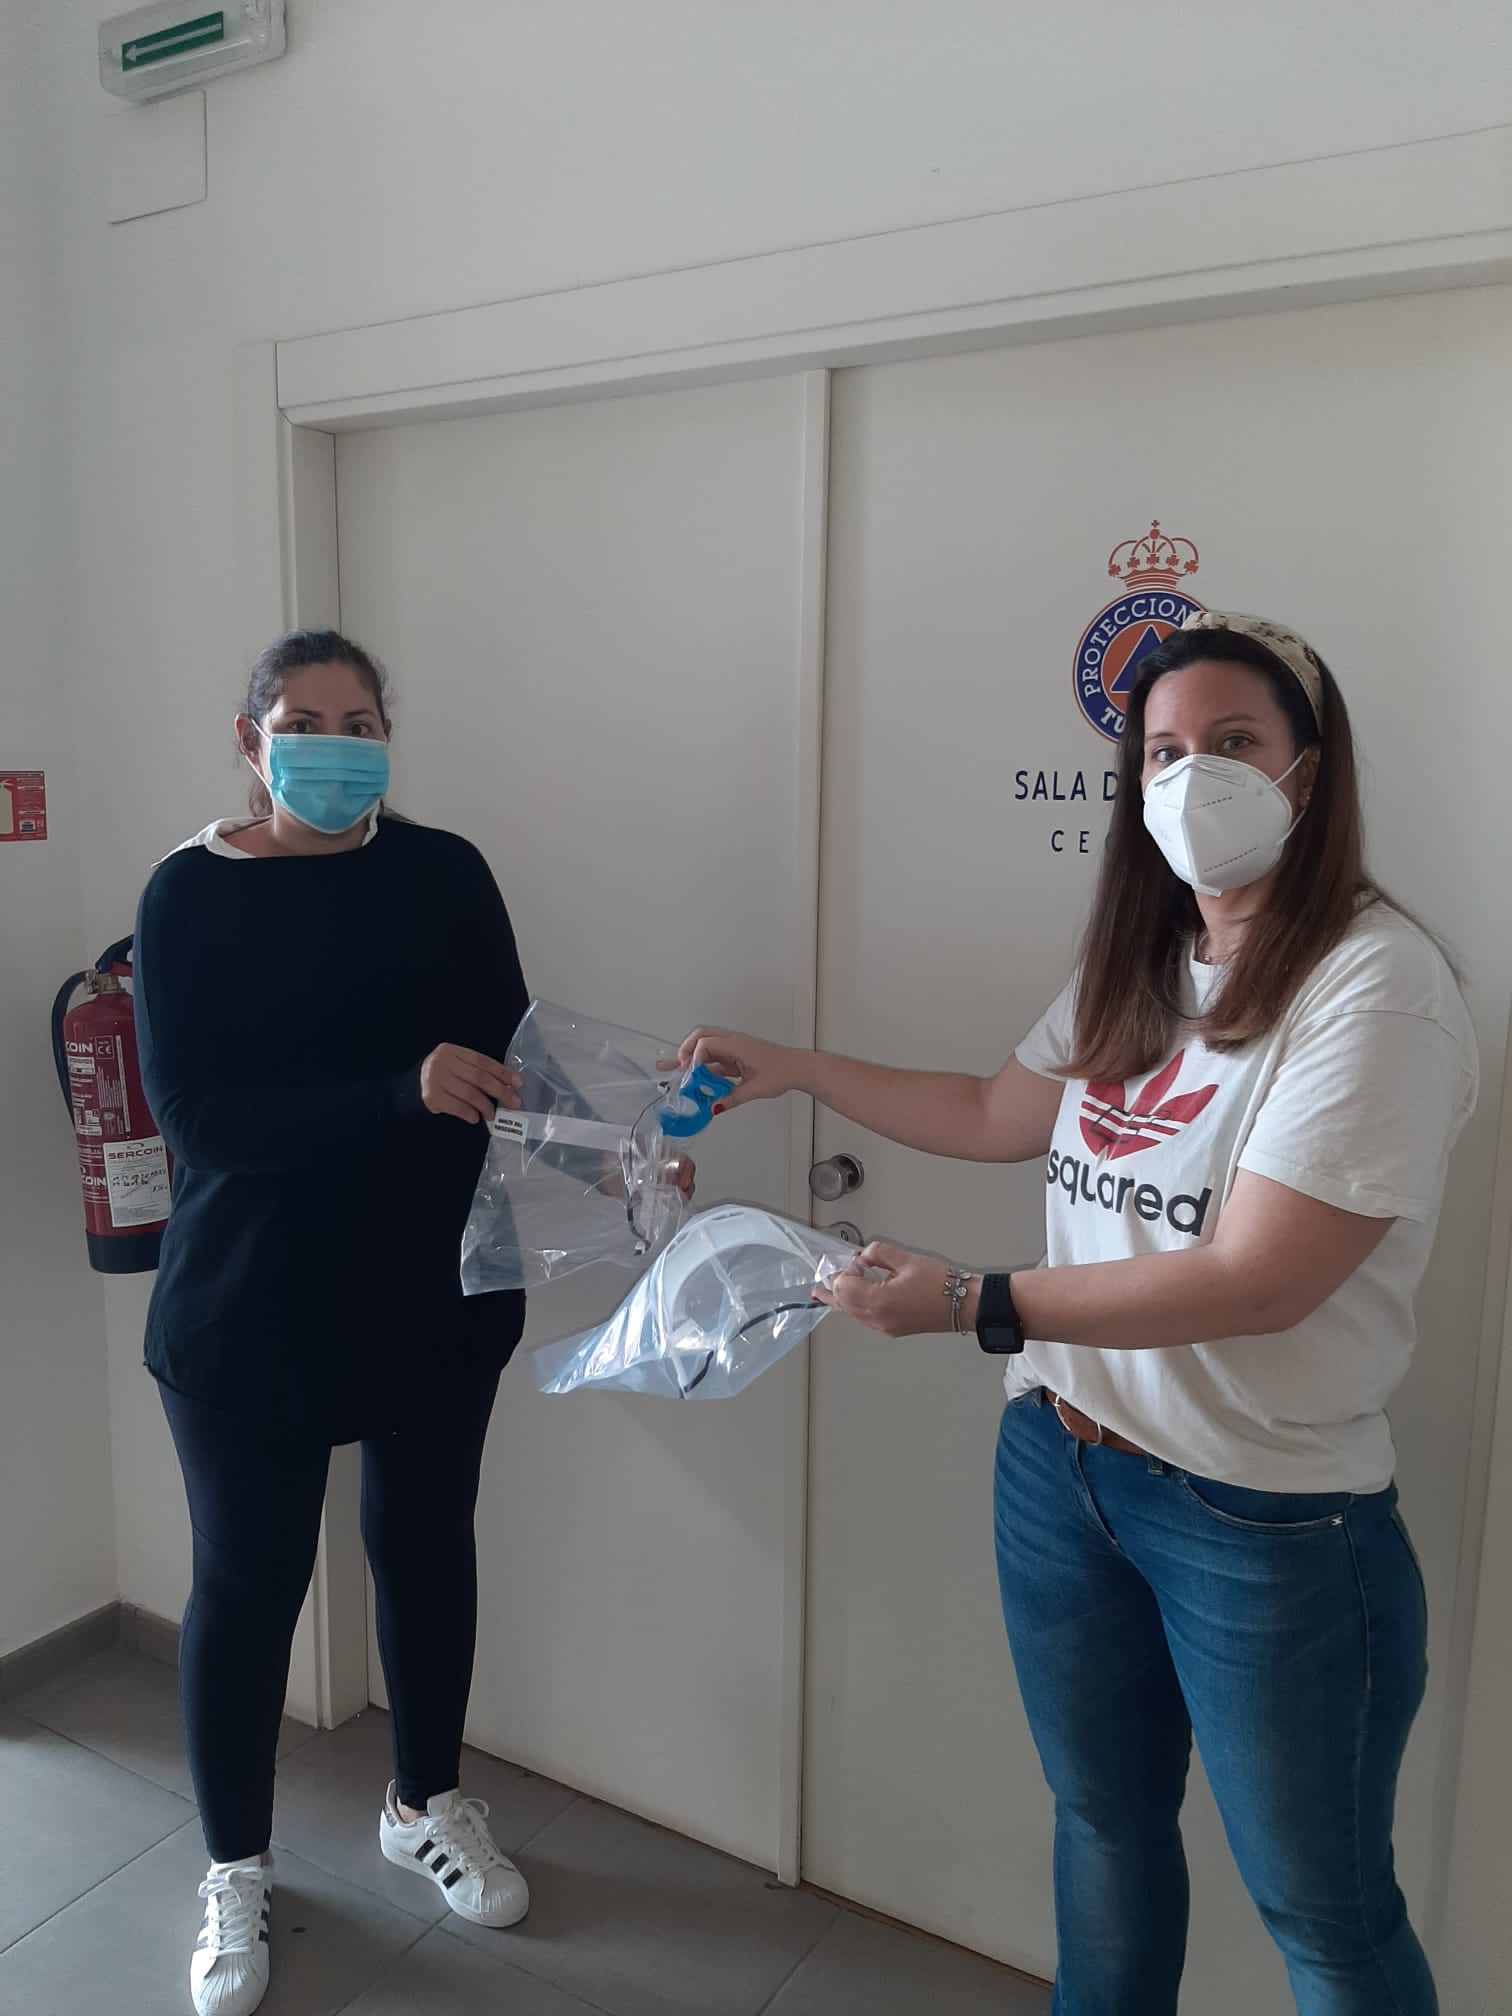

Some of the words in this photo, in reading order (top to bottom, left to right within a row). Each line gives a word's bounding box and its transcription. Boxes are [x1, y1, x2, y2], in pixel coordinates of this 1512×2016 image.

[1082, 598, 1193, 699] PROTECCION
[1015, 770, 1087, 801] SALA
[108, 1145, 164, 1160] SERCOIN
[1047, 1149, 1213, 1237] squared
